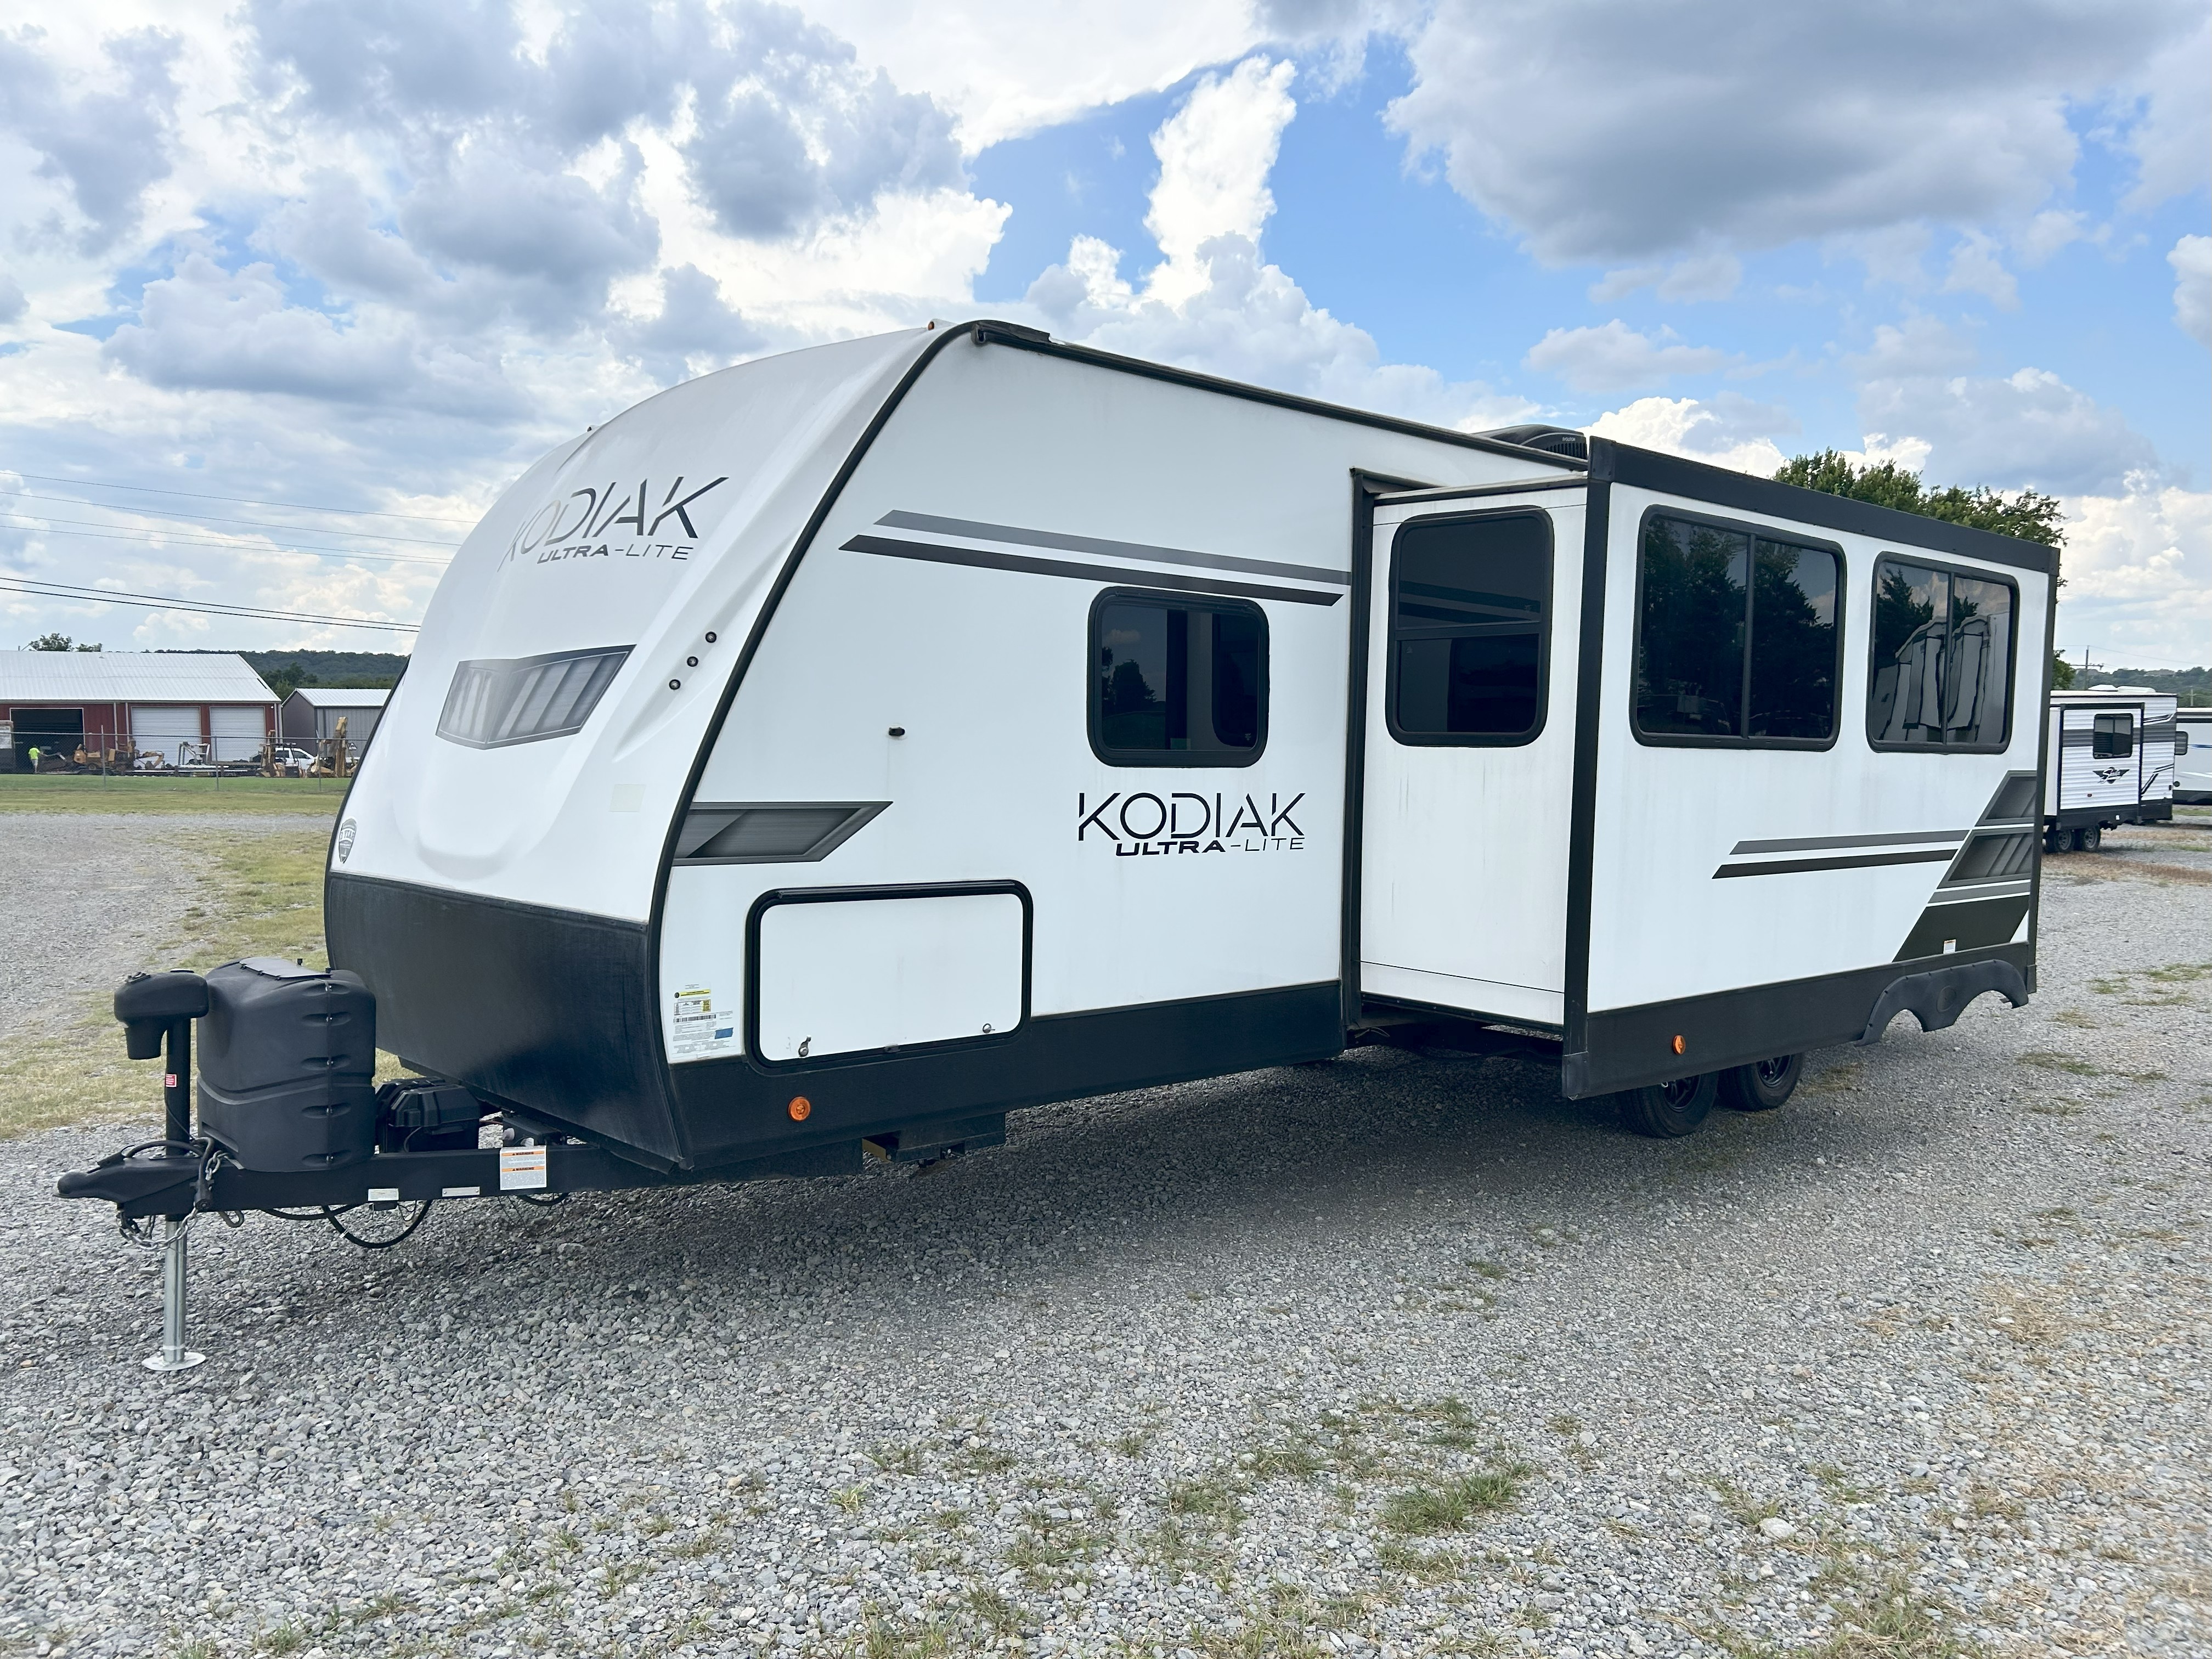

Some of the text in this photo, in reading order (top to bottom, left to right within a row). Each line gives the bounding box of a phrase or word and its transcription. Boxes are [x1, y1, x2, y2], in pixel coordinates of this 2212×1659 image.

[497, 476, 729, 572] KODIAK
[537, 544, 694, 565] ULTRA-LITE
[1078, 792, 1306, 842] KODIAK
[1115, 837, 1305, 857] ULTRA-LITE
